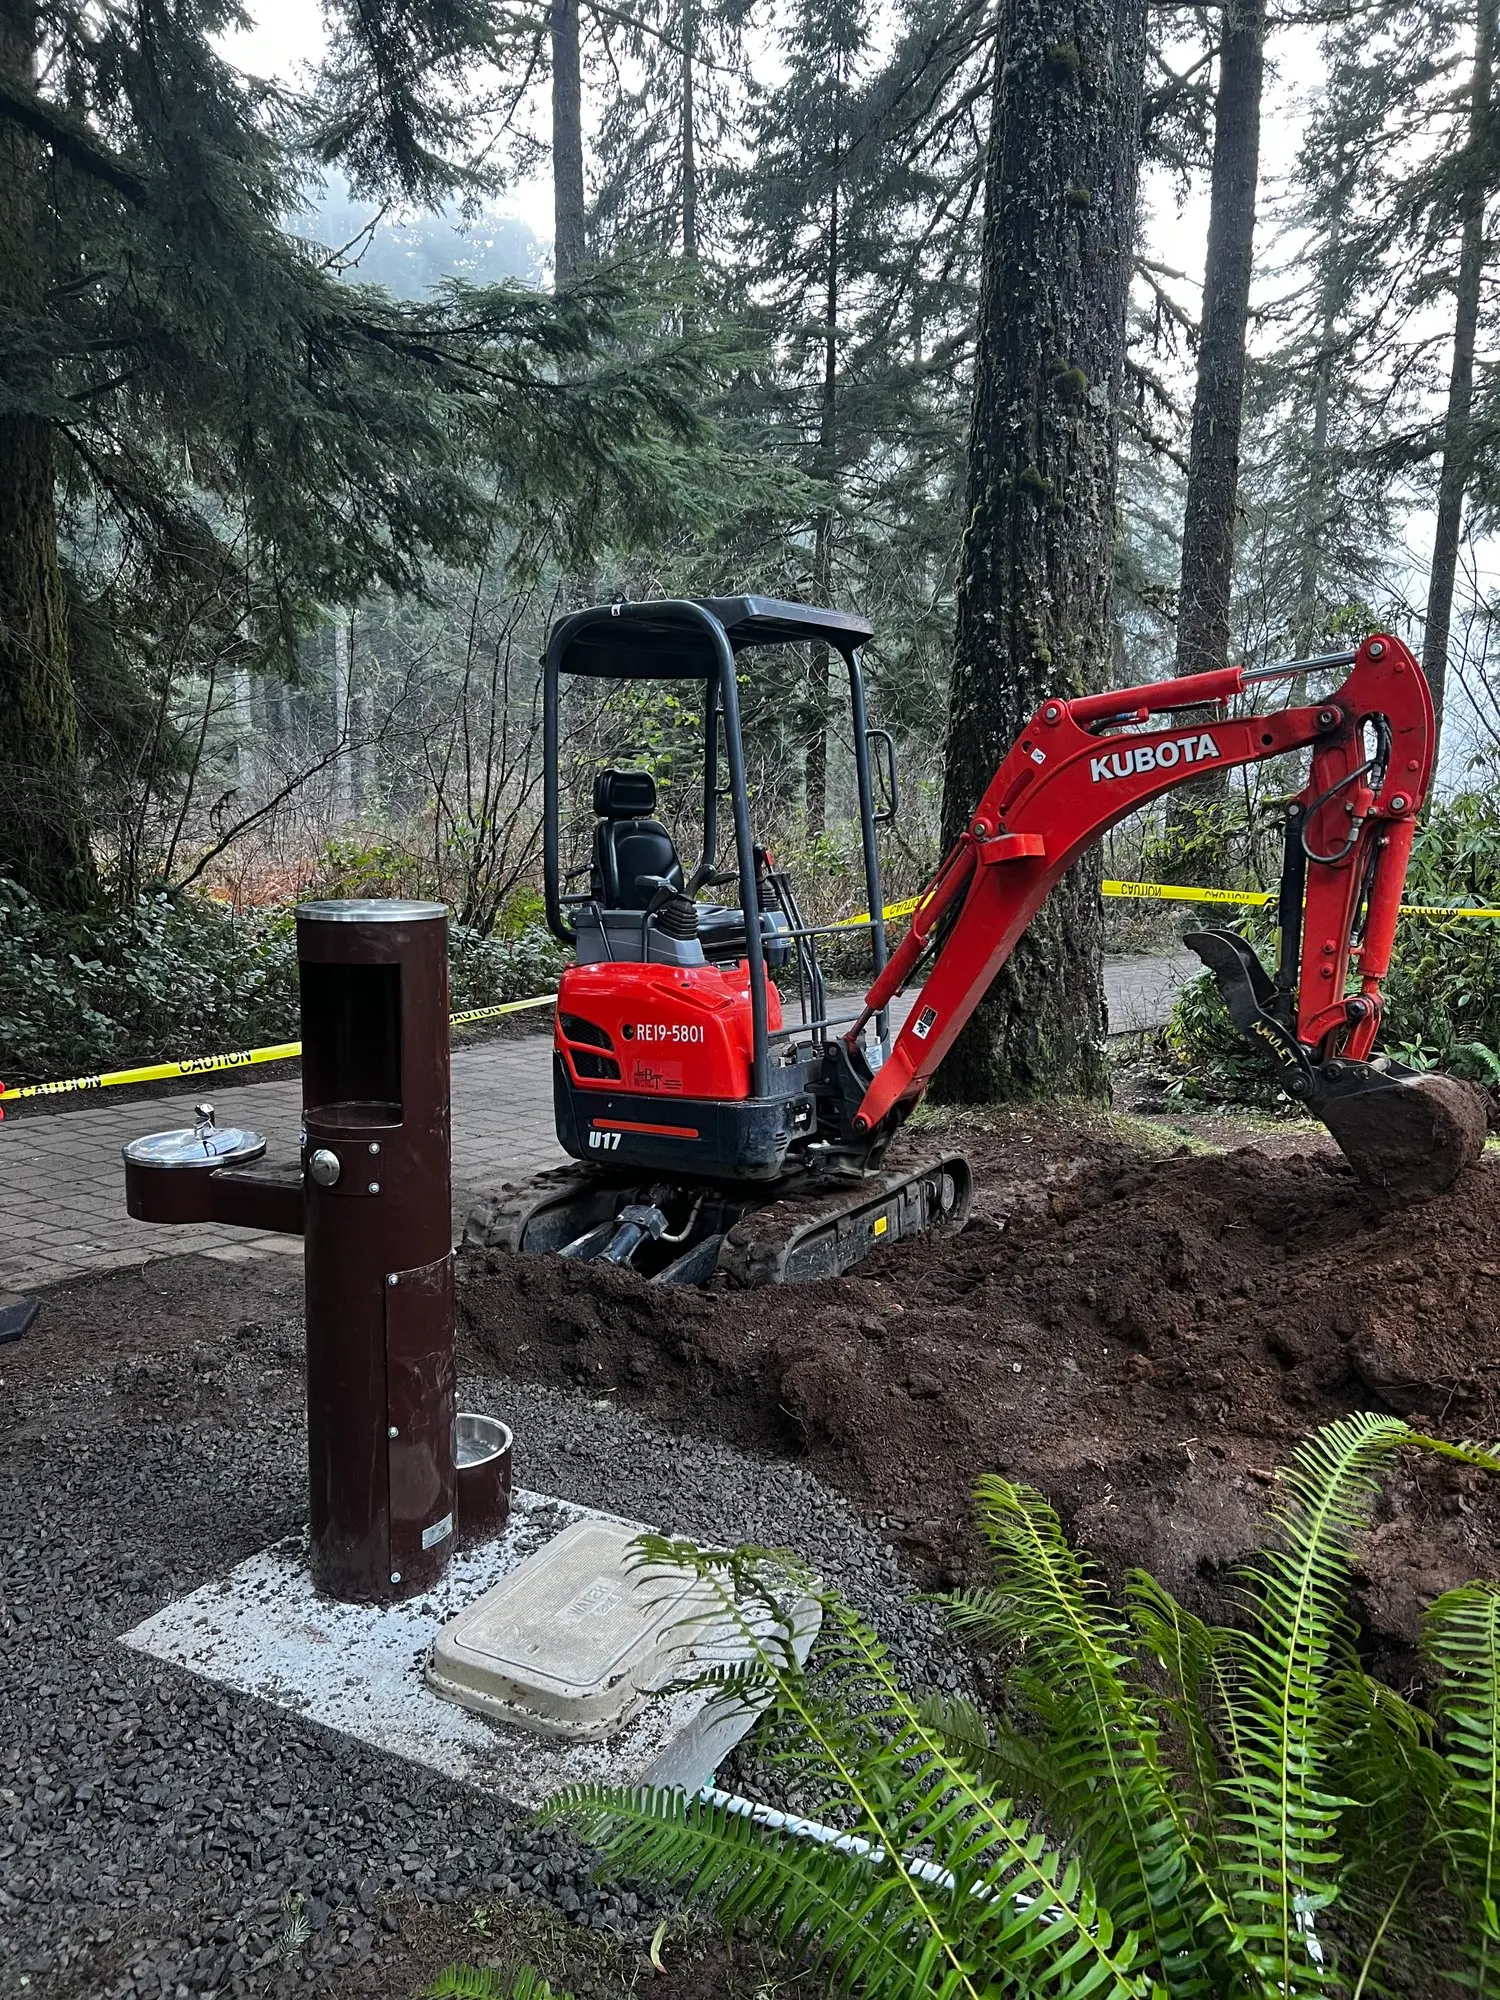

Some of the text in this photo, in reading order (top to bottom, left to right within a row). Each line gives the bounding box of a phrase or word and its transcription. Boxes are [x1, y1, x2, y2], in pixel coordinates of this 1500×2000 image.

[1089, 733, 1220, 782] KUBOTA
[636, 1023, 704, 1043] RE19-5801
[1249, 1021, 1297, 1067] AMULET
[179, 1050, 251, 1074] CAUTION
[588, 1131, 622, 1151] U17
[567, 1585, 610, 1615] WATER
